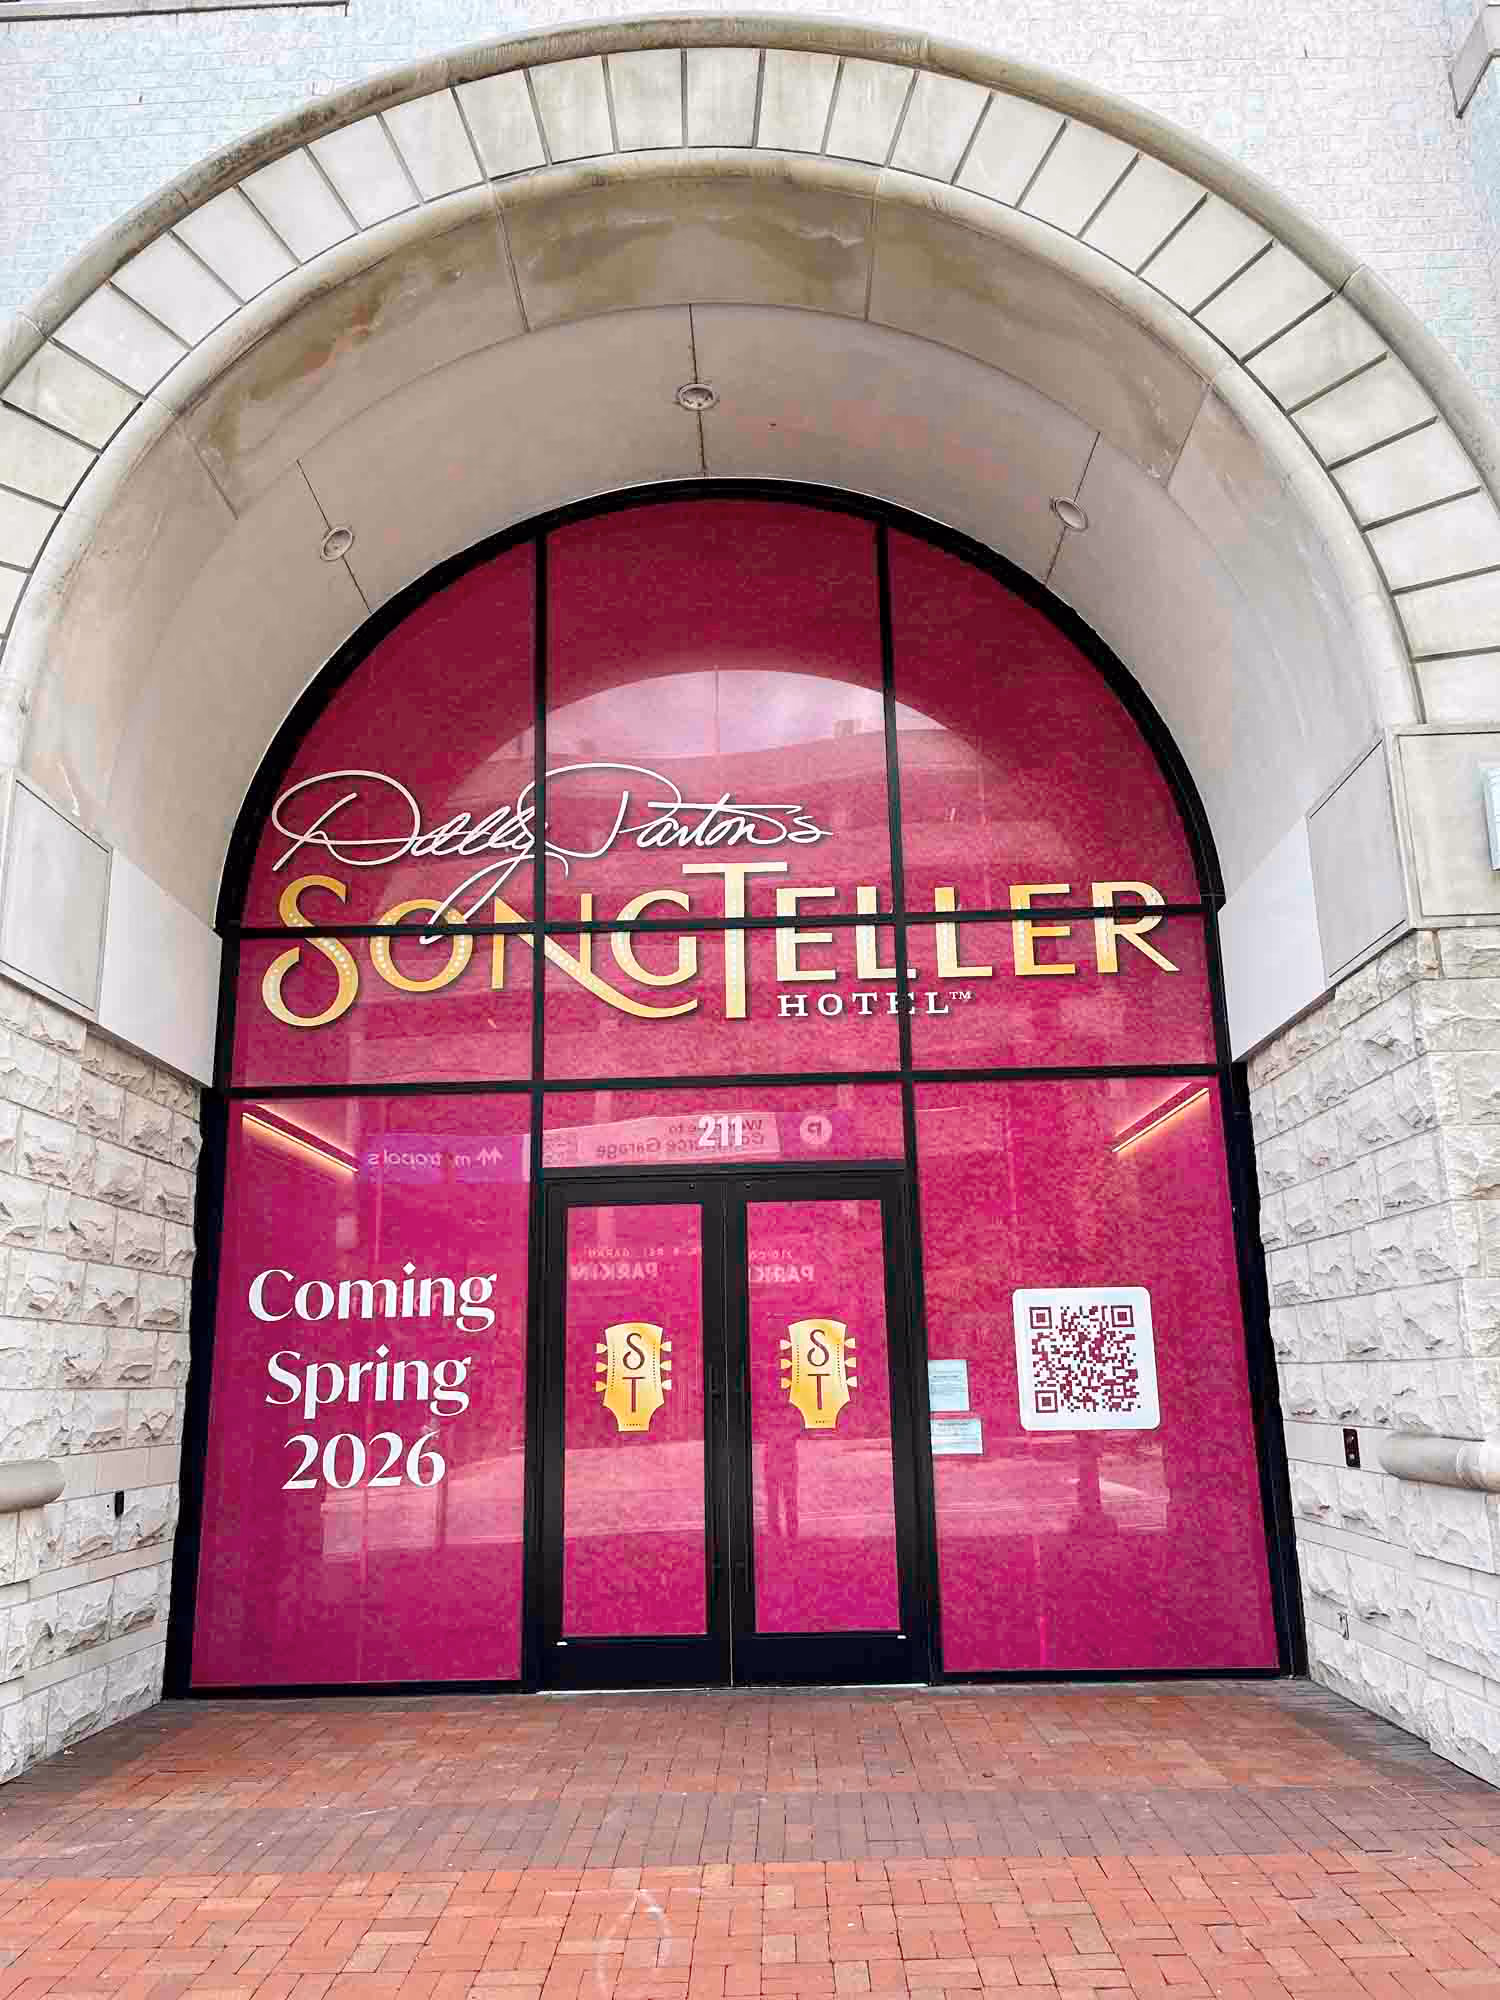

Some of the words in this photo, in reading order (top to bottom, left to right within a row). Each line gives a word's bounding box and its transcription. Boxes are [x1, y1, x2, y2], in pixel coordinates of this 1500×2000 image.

[271, 769, 570, 945] Dolly
[698, 1115, 743, 1147] 211
[248, 1261, 498, 1333] Coming
[264, 1343, 472, 1420] Spring
[281, 1430, 447, 1490] 2026
